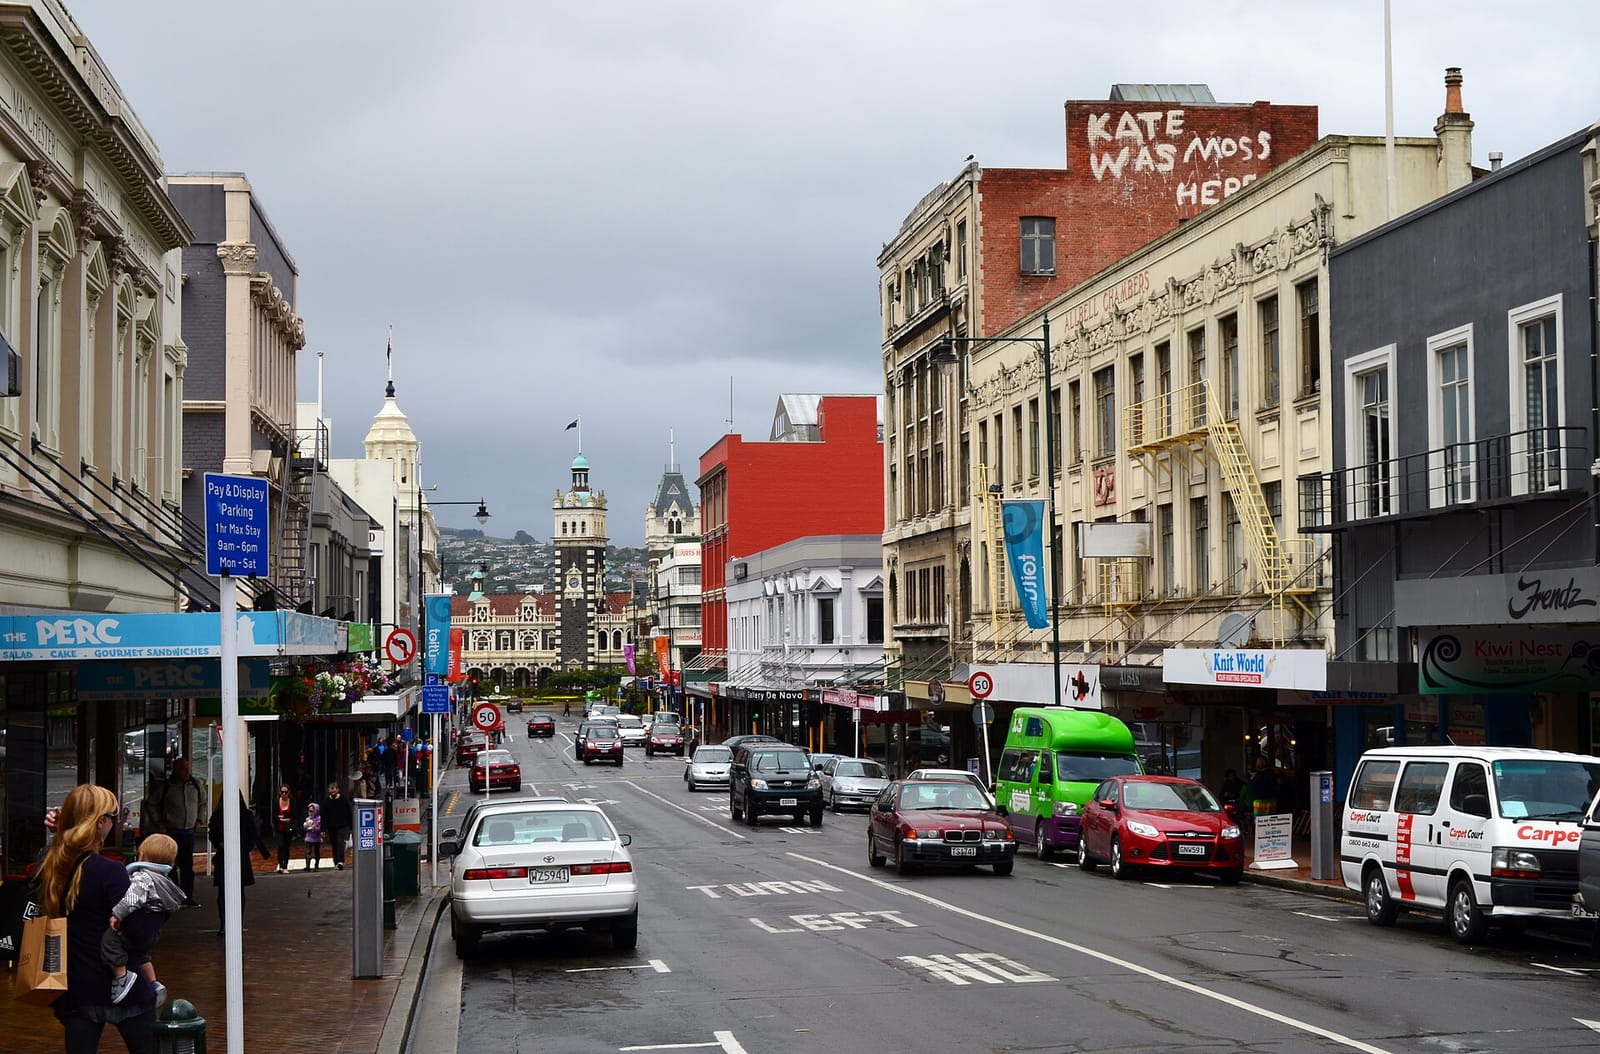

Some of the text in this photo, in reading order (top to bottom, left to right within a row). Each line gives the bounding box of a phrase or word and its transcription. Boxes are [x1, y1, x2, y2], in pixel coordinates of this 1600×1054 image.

[12, 87, 56, 157] MANCHESTER
[1087, 109, 1185, 148] KATE
[1183, 131, 1272, 163] MOSS
[1090, 143, 1178, 181] WAS
[1103, 271, 1149, 311] CHAMBERS
[208, 482, 265, 502] Pay & Display
[221, 503, 253, 520] Parking
[216, 523, 260, 538] 1hr Max Stay
[218, 540, 235, 551] 9am
[241, 541, 258, 553] 6pm
[220, 557, 236, 568] Mon
[243, 558, 256, 569] Sat
[3, 618, 122, 646] THE PERC
[3, 647, 209, 659] SALAD CAKE GOURMET SANDWICHES
[1475, 639, 1562, 656] Kiwi Nest
[1213, 653, 1264, 673] Knit World
[133, 664, 205, 687] PERC
[428, 676, 435, 684] P
[975, 680, 988, 690] 50
[766, 691, 777, 700] De
[780, 691, 803, 700] Novo
[479, 712, 495, 723] 50
[362, 811, 373, 827] P
[1350, 811, 1381, 824] Carpet Court
[1450, 827, 1484, 840] Carpet Court
[1517, 825, 1584, 846] Carpe
[531, 869, 567, 881] WZ5941
[686, 880, 845, 898] TURN
[749, 910, 919, 934] LEFT
[897, 952, 1061, 985] NO
